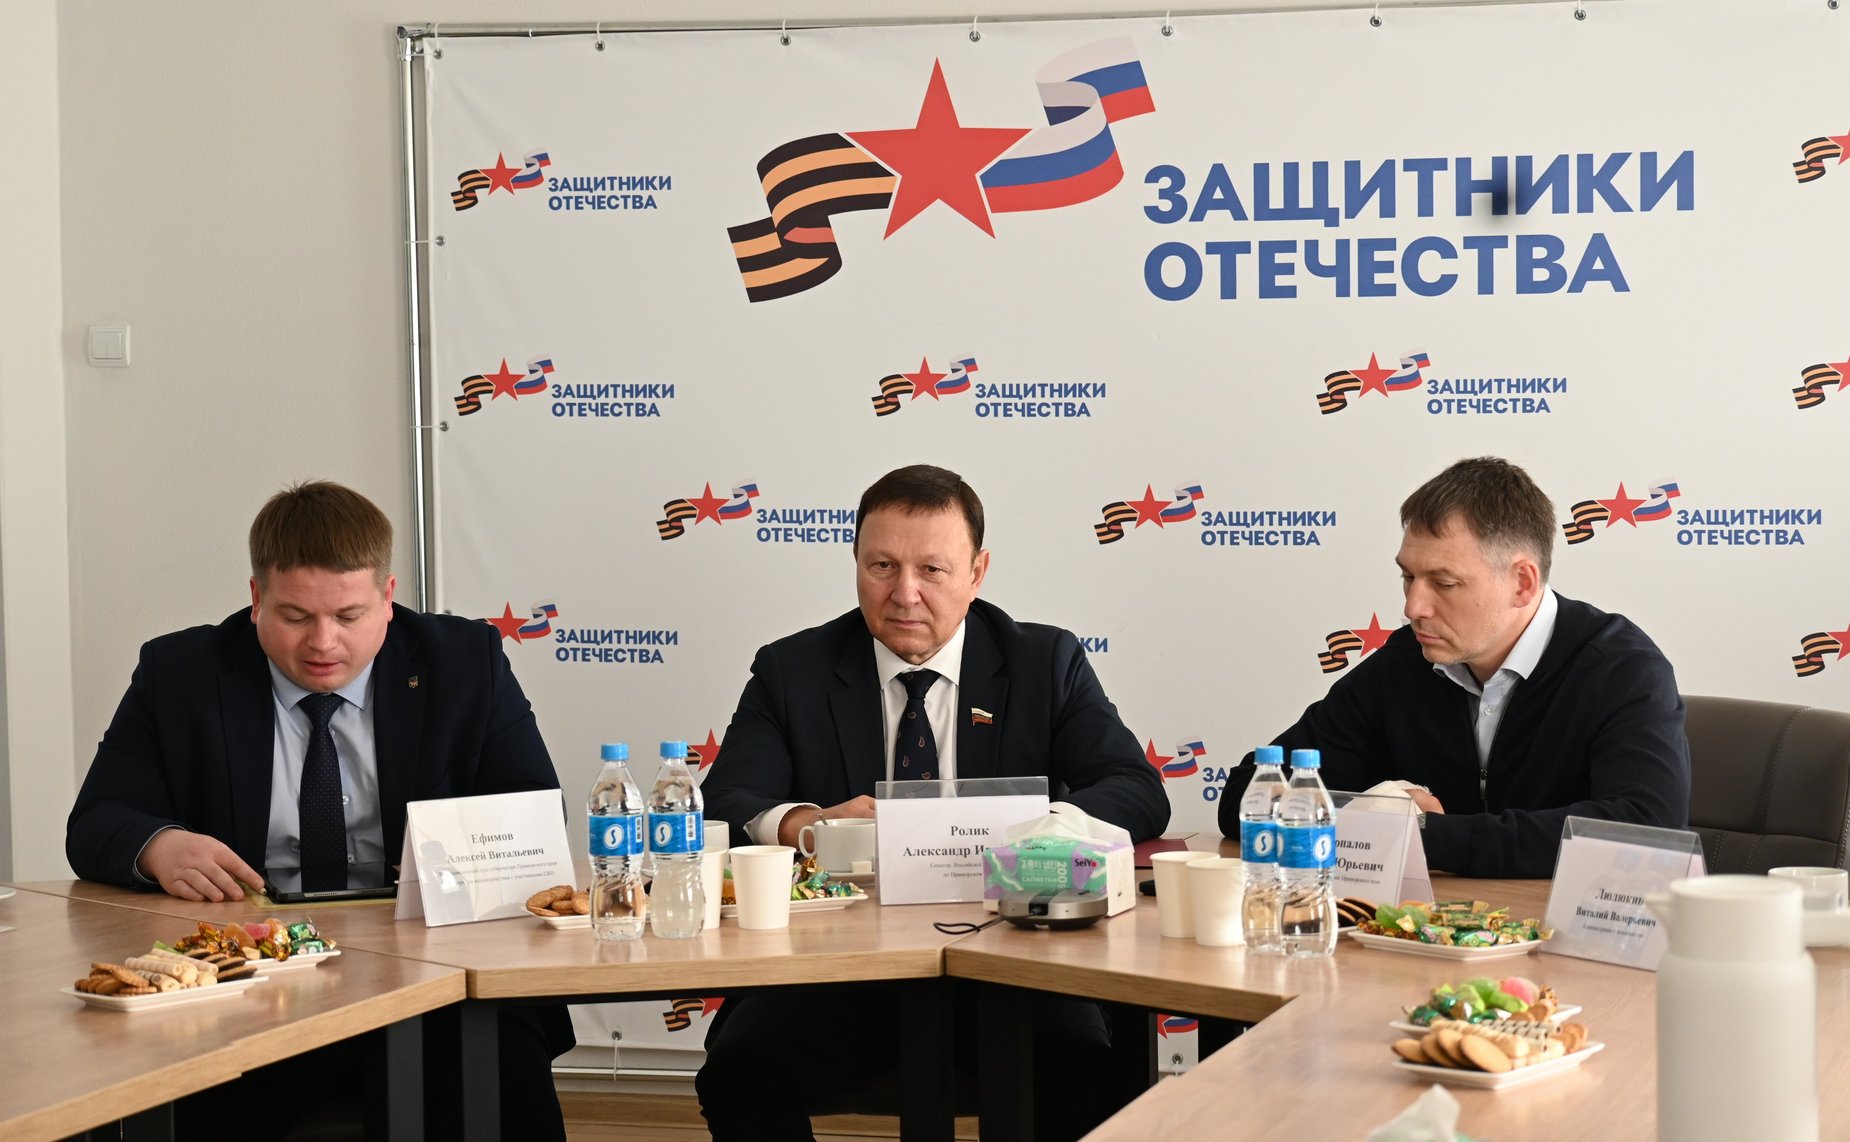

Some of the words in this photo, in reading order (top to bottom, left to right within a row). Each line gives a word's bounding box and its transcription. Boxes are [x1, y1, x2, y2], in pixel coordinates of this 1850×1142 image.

[548, 176, 672, 193] ЗАЩИТНИКИ
[1143, 150, 1695, 228] ЗАЩИТНИКИ
[548, 195, 657, 211] ОТЕЧЕСТВА
[1143, 232, 1631, 302] ОТЕЧЕСТВА
[551, 384, 675, 400] ЗАЩИТНИКИ
[975, 382, 1107, 401] ЗАЩИТНИКИ
[1427, 377, 1568, 397] ЗАЩИТНИКИ
[551, 402, 660, 417] ОТЕЧЕСТВА
[975, 402, 1091, 417] ОТЕЧЕСТВА
[1427, 397, 1551, 415] ОТЕЧЕСТВА
[756, 508, 858, 526] ЗАЩИТНИ
[1200, 510, 1337, 529] ЗАЩИТНИКИ
[1676, 508, 1823, 527] ЗАЩИТНИКИ
[756, 527, 855, 543] ОТЕЧЕСТВ
[1200, 529, 1321, 546] ОТЕЧЕСТВА
[1676, 528, 1805, 546] ОТЕЧЕСТВА
[555, 629, 679, 646] ЗАЩИТНИКИ
[555, 647, 665, 664] ОТЕЧЕСТВА
[471, 832, 514, 845] Ефимов
[950, 825, 990, 836] Ролик
[903, 846, 971, 858] Александр
[1335, 839, 1371, 850] опалов
[447, 851, 487, 864] Алексей
[489, 847, 545, 860] Витальевич
[1335, 857, 1384, 872] Юрьевич
[1576, 906, 1610, 920] Виталий
[1610, 913, 1657, 928] Валерьевич
